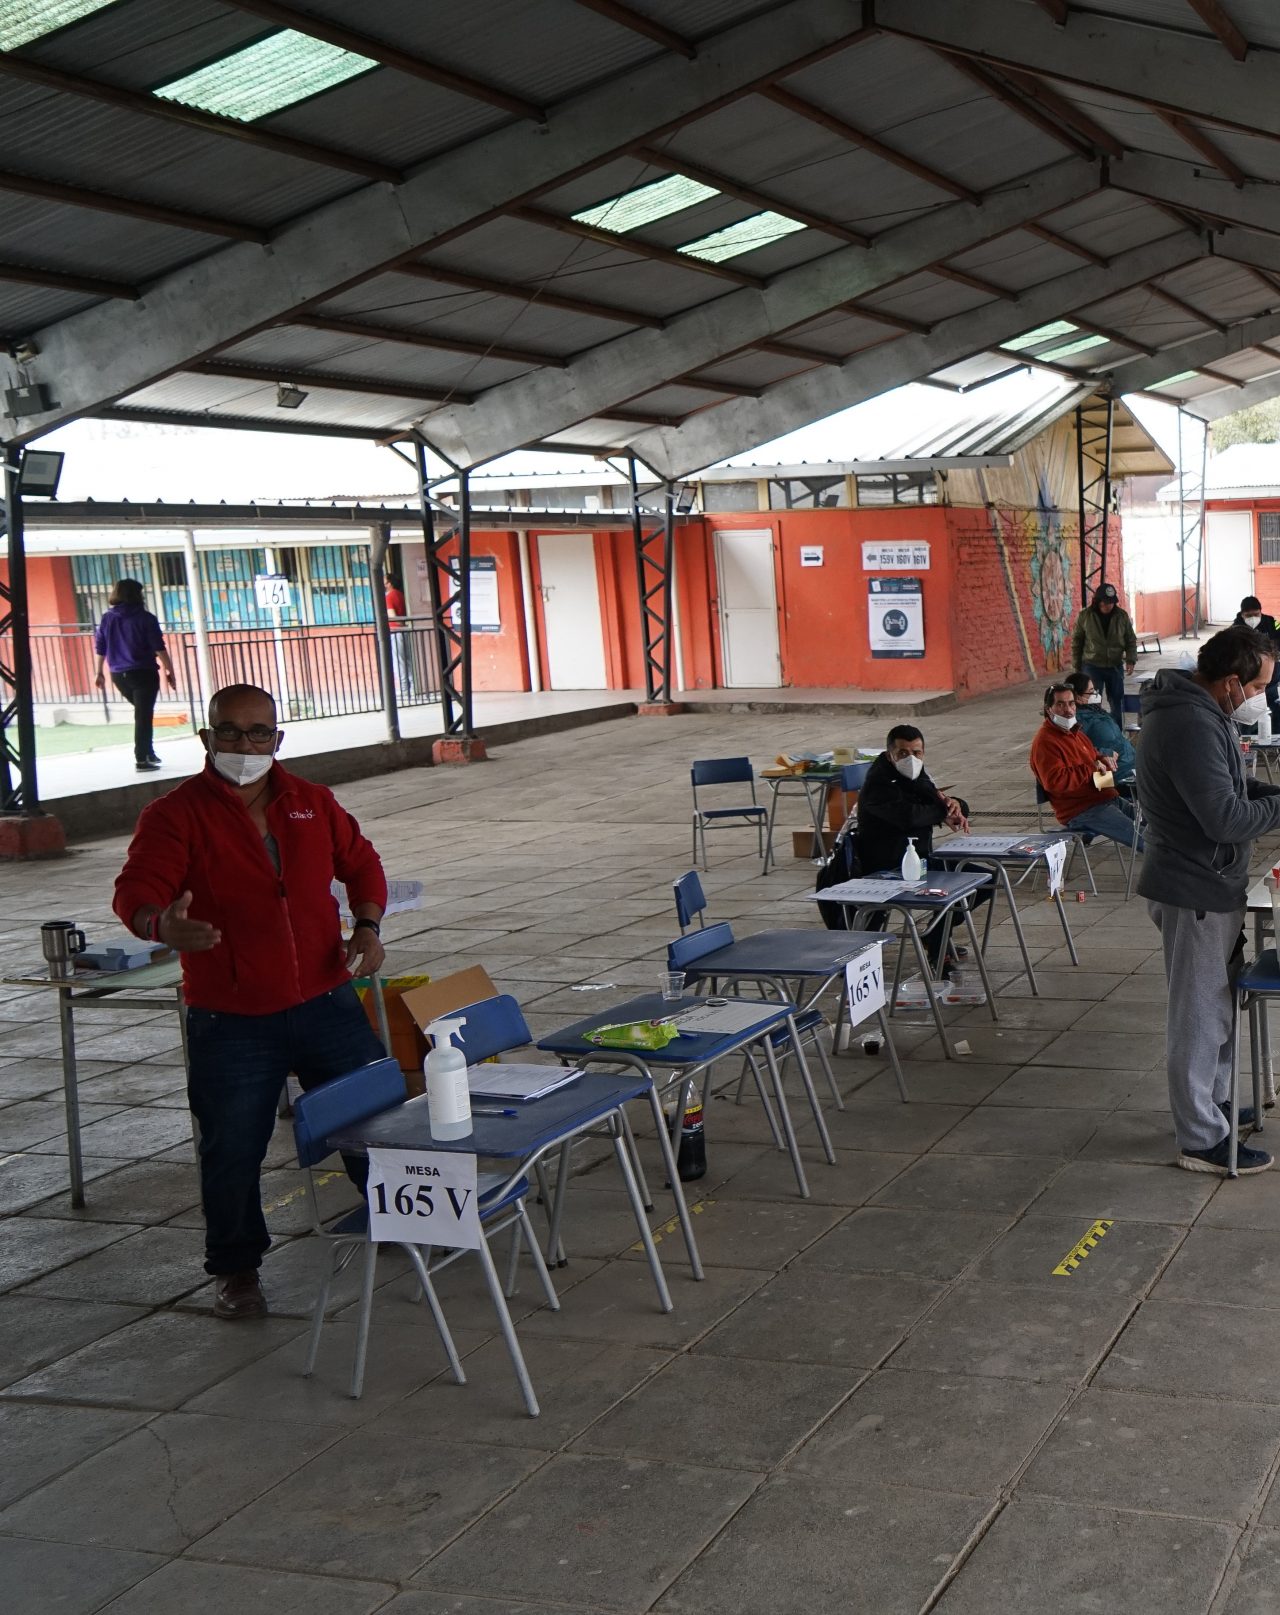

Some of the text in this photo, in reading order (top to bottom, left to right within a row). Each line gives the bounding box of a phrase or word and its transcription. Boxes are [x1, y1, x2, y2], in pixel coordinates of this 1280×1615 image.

[880, 554, 927, 565] 159V 160V 161V
[262, 583, 287, 605] 161
[290, 811, 313, 819] Claro
[860, 960, 871, 972] MESA
[850, 967, 881, 1007] 165 V
[404, 1165, 441, 1177] MESA
[372, 1182, 473, 1221] 165 V
